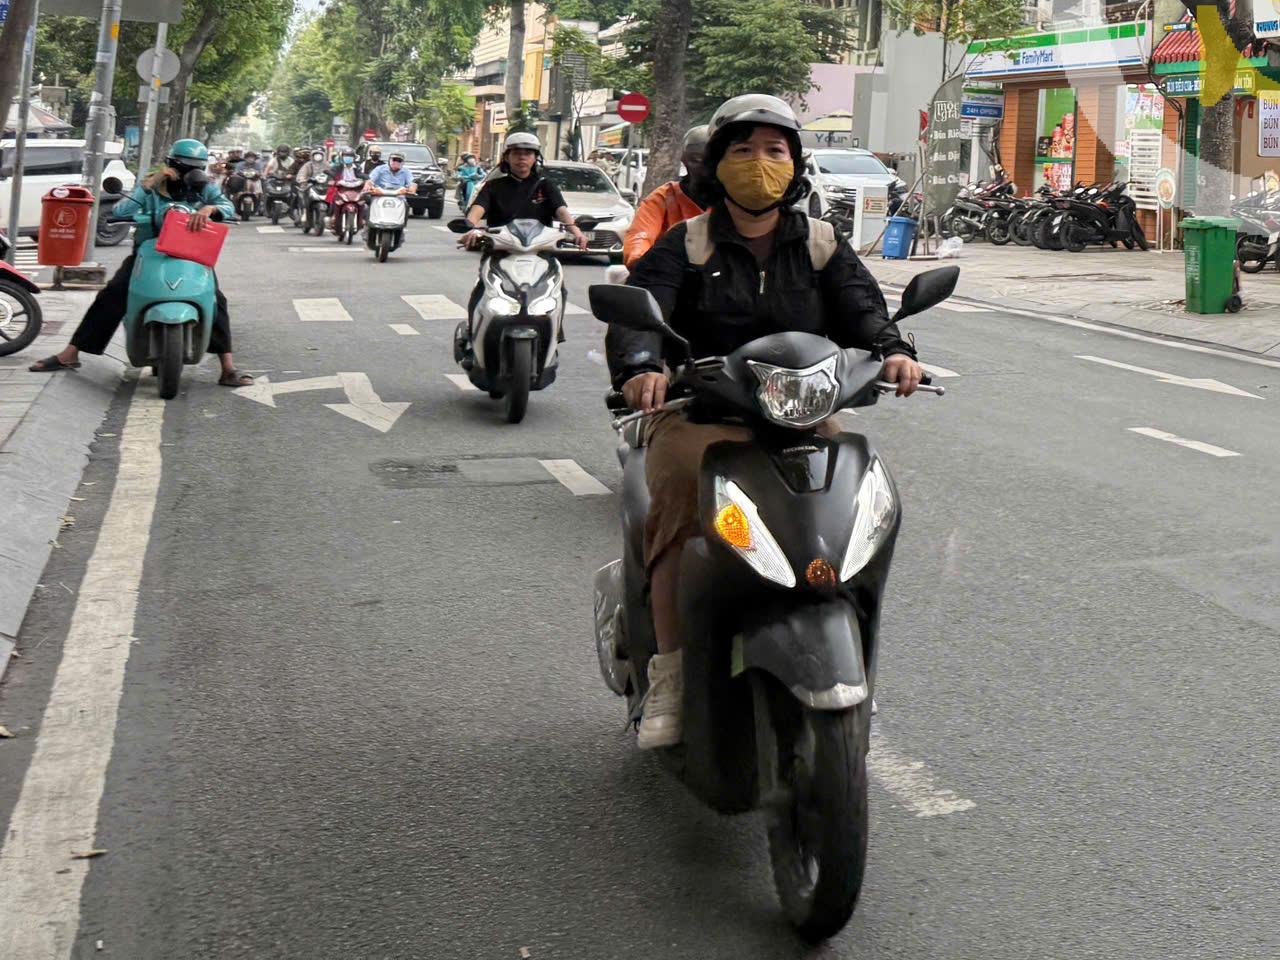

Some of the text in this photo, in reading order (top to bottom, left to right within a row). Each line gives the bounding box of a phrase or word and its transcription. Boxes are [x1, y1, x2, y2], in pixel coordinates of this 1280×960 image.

[1021, 50, 1054, 65] FamilyMart
[1263, 96, 1279, 110] BÚN
[1263, 115, 1279, 130] BÚN
[1263, 134, 1279, 149] BÚN
